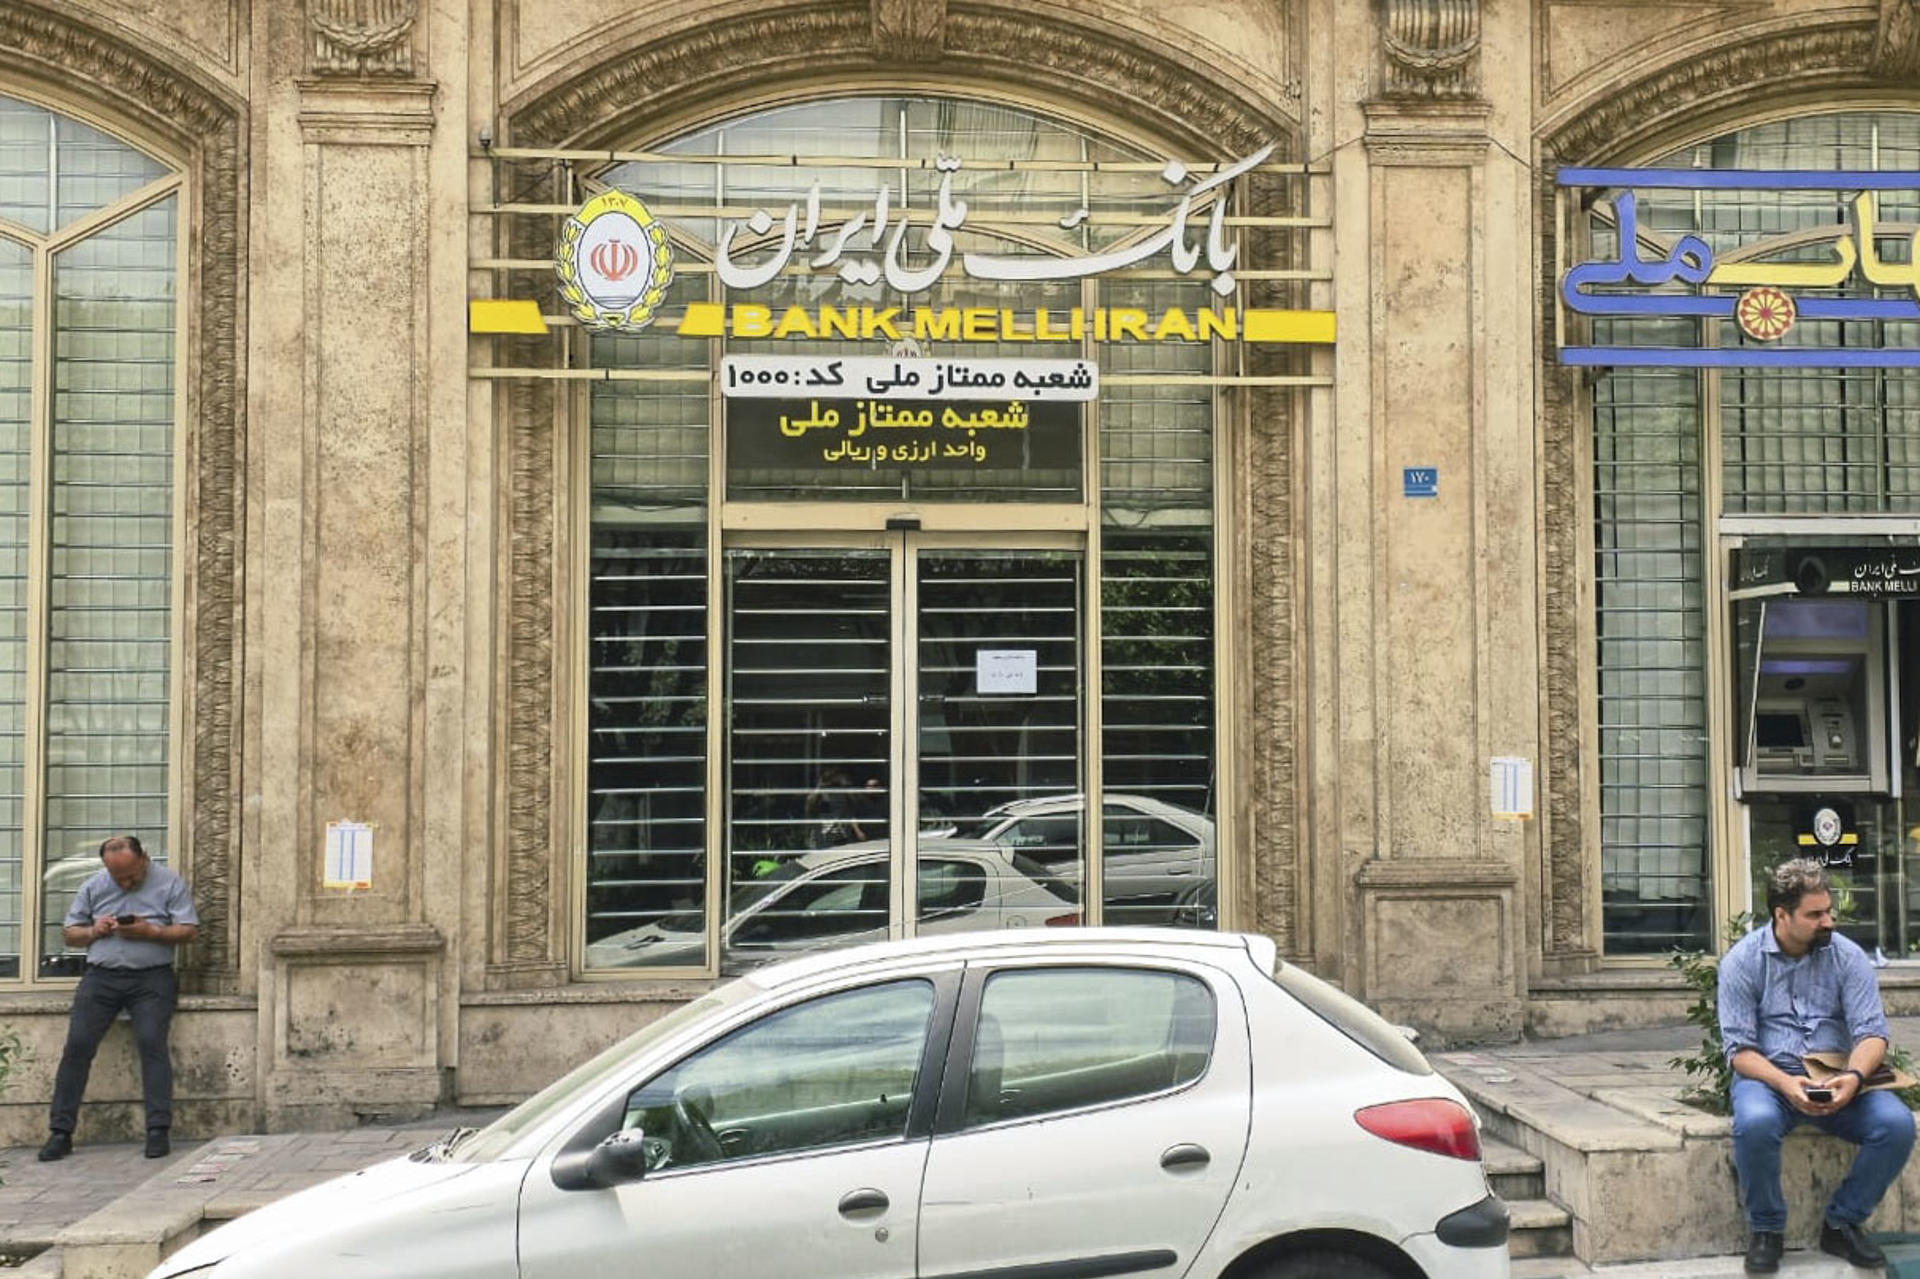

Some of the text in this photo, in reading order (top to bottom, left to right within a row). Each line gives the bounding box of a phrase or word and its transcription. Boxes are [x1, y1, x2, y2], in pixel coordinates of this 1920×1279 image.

[715, 177, 891, 290] ایران
[963, 144, 1274, 297] بانک
[731, 304, 1238, 342] BANK MELLI IRAN
[866, 363, 920, 394] ملی
[928, 364, 1006, 394] ممتاز
[1013, 363, 1093, 395] شعبه
[779, 400, 1030, 436] شعبه ممتاز ملی
[892, 440, 937, 461] ارزی
[943, 440, 986, 461] واحد
[1851, 579, 1918, 592] BANK MELLI
